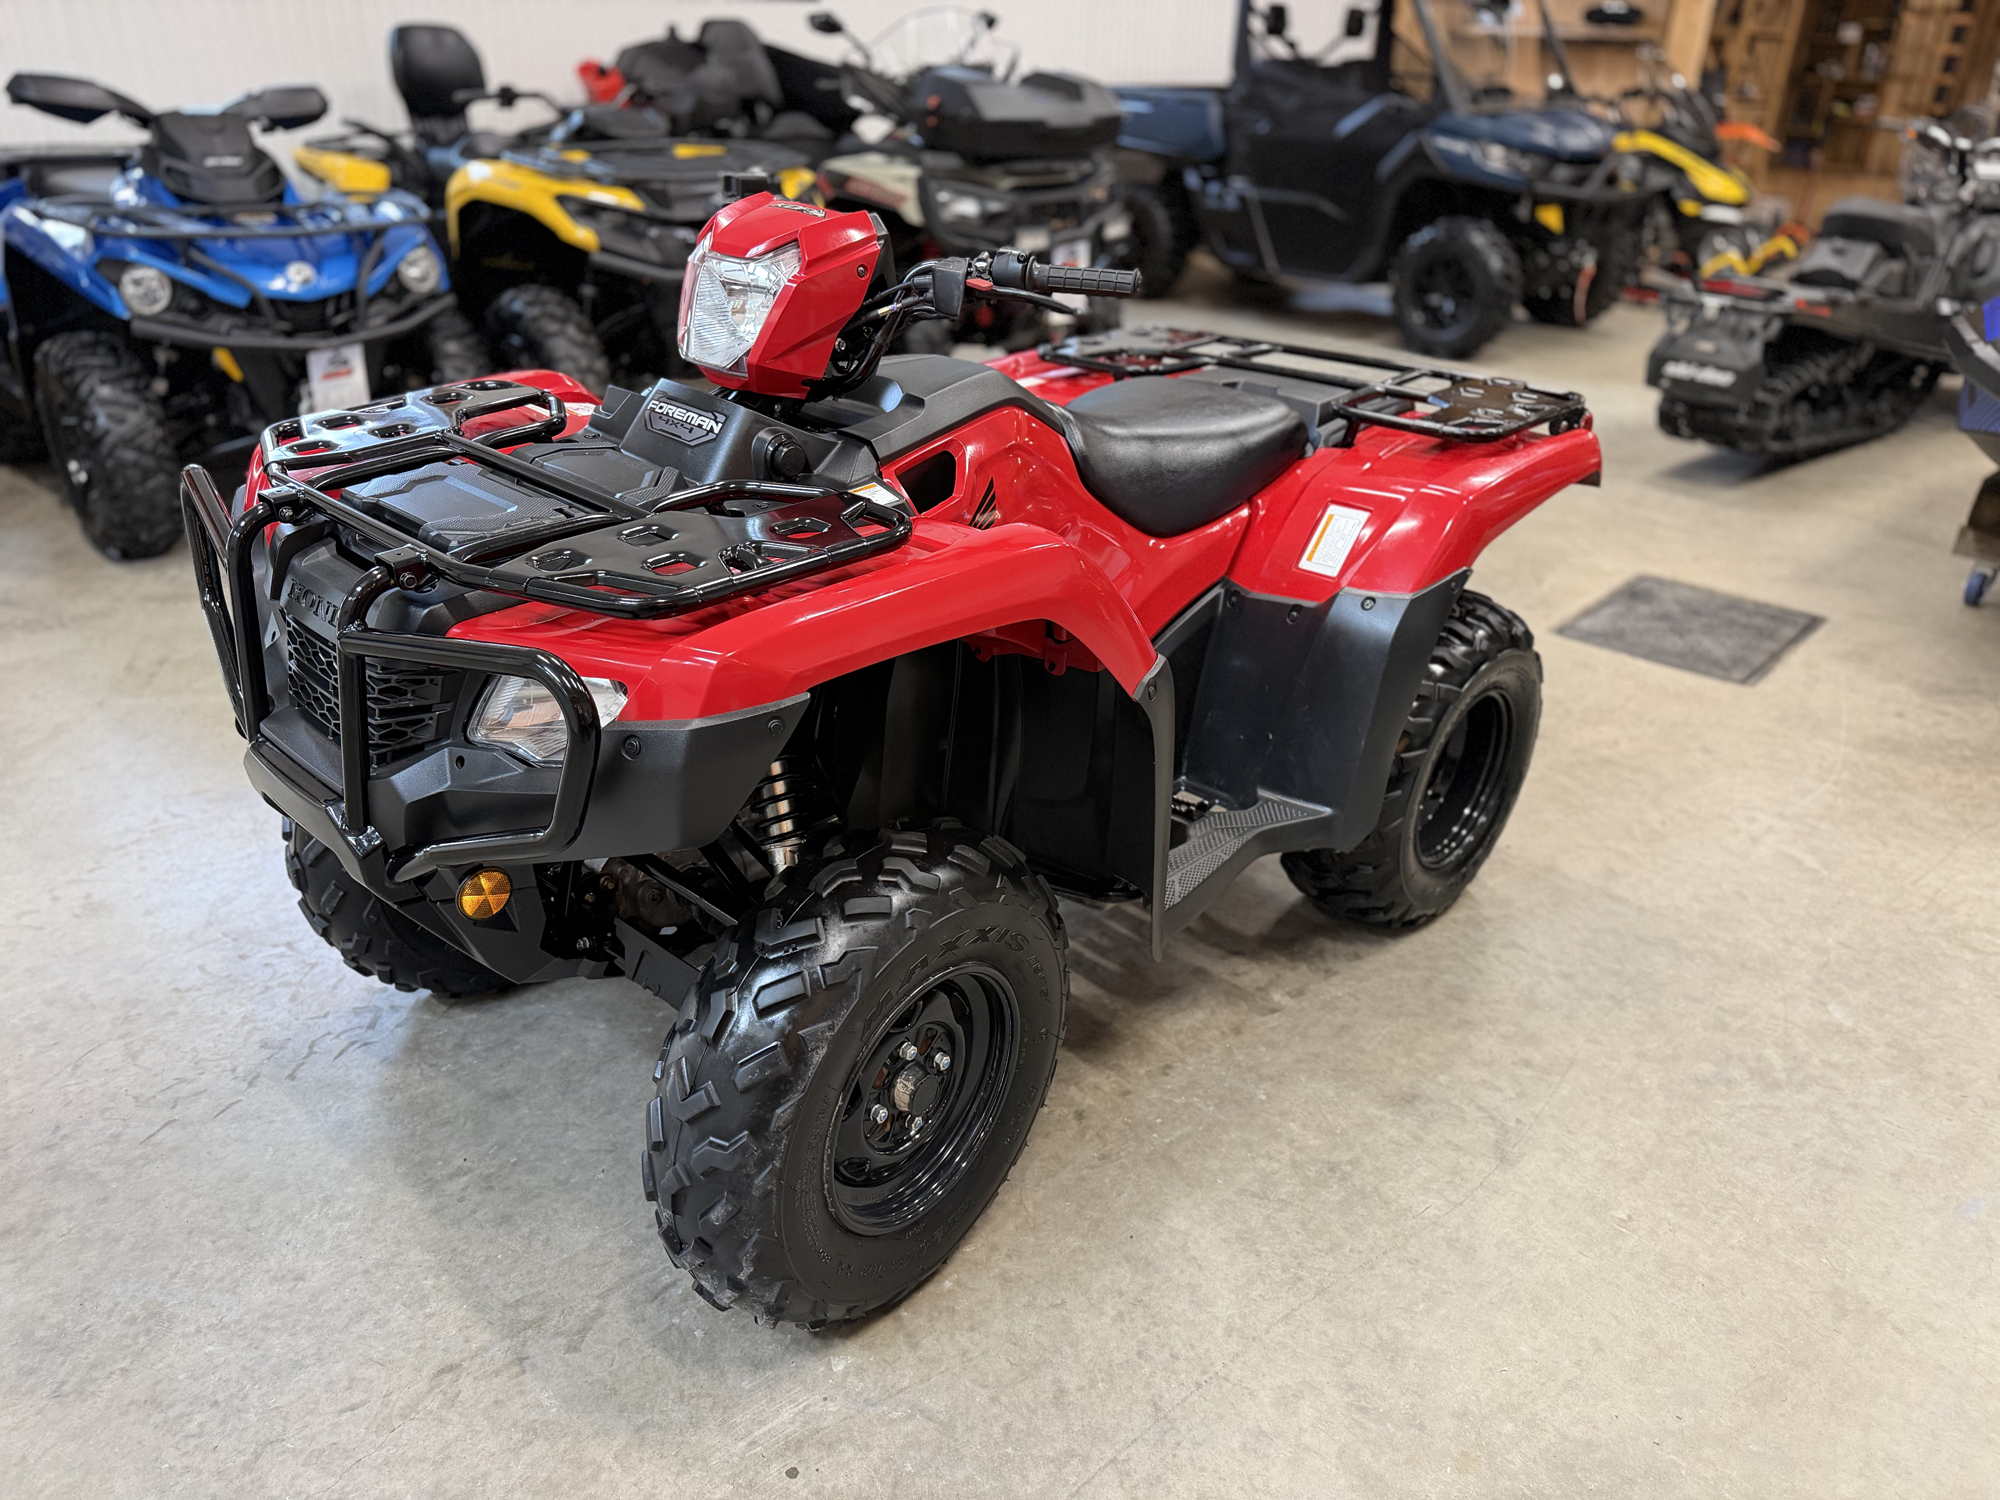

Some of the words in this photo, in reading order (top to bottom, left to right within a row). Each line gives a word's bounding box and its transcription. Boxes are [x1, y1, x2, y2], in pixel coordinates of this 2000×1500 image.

[647, 400, 723, 434] FOREMAN
[287, 578, 340, 628] HON
[860, 926, 1030, 1041] MAXXIS
